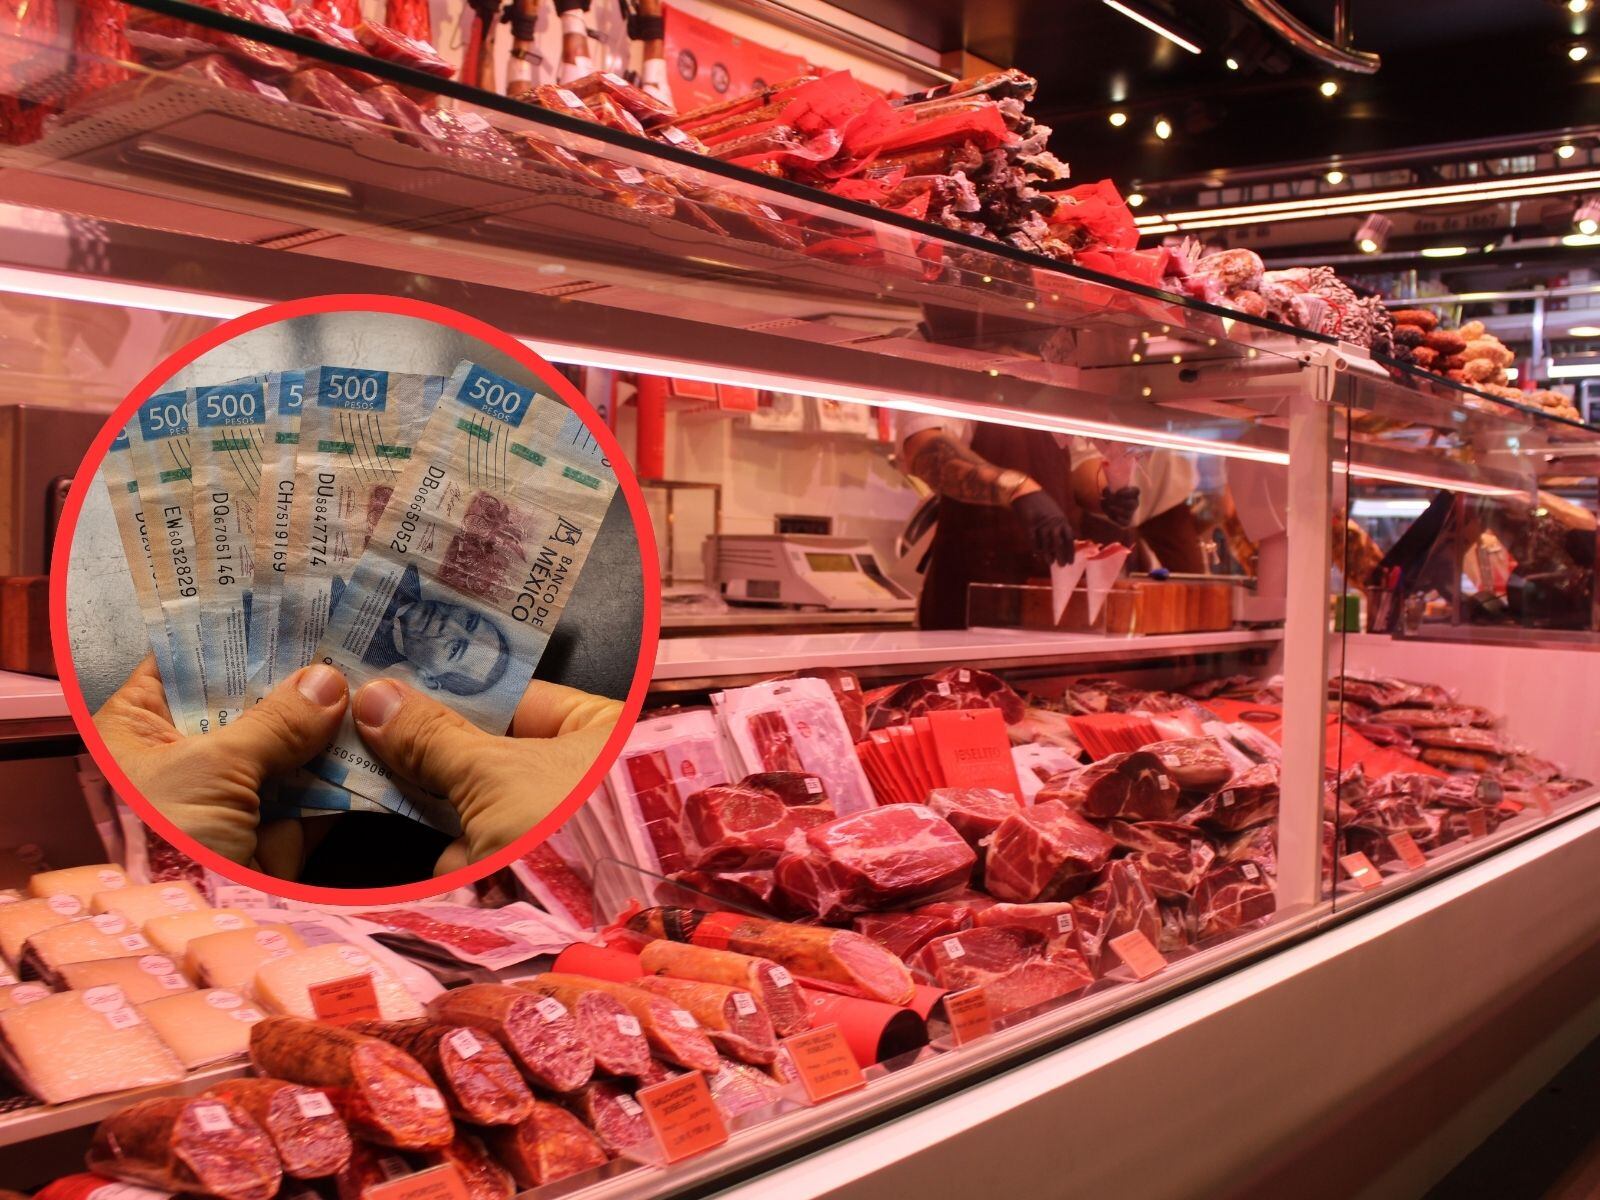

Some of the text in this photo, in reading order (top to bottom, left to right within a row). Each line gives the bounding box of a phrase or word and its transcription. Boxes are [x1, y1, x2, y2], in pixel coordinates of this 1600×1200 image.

[206, 393, 256, 419] 500
[327, 374, 378, 401] 500
[344, 401, 374, 410] PESOS
[468, 376, 521, 414] 500
[481, 405, 511, 422] PESOS
[224, 416, 255, 425] PESOS
[272, 480, 295, 572] CH7519169
[309, 473, 336, 567] DU5847774
[390, 465, 446, 554] DB0665052
[164, 505, 197, 598] EW6032829
[212, 492, 235, 586] DQ6705146
[531, 555, 573, 627] BANCO DE
